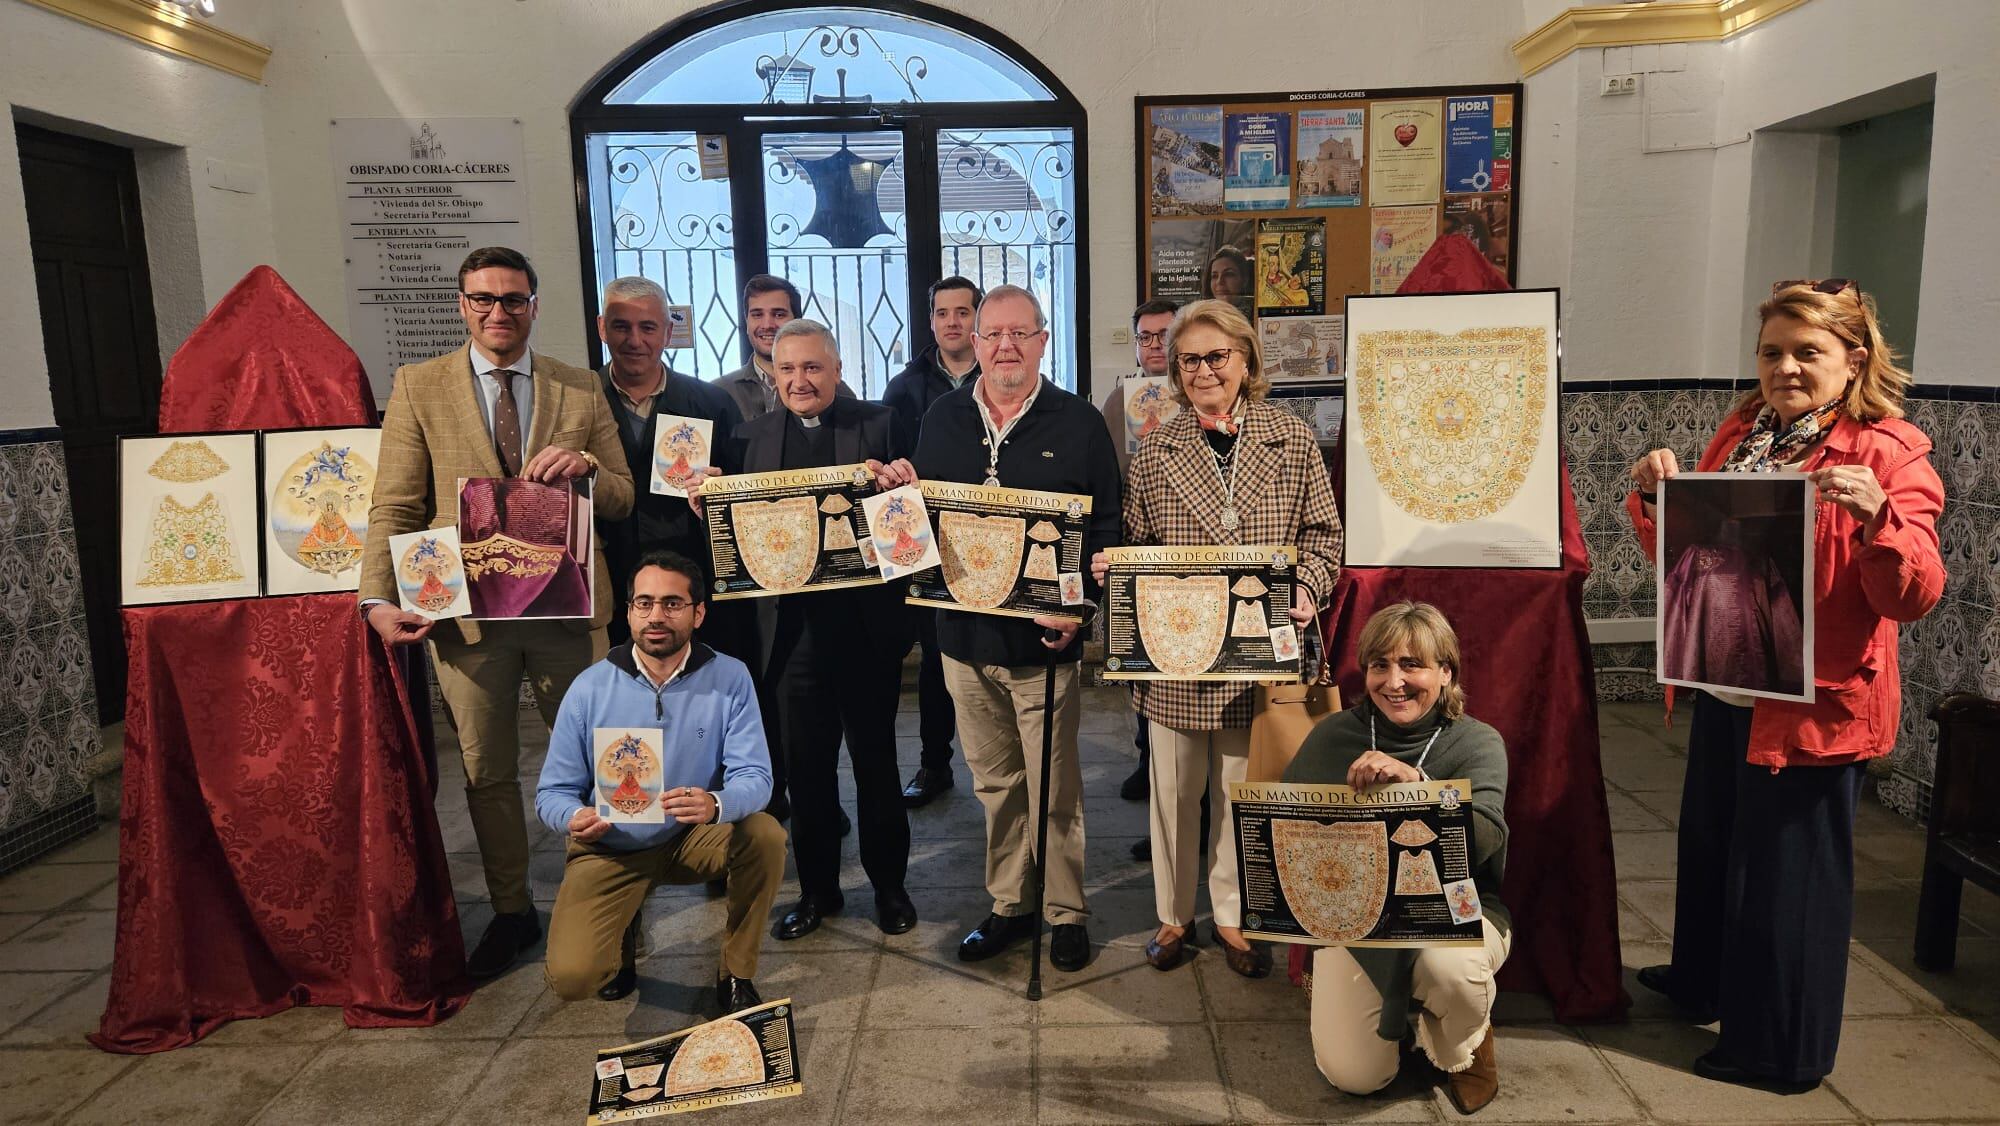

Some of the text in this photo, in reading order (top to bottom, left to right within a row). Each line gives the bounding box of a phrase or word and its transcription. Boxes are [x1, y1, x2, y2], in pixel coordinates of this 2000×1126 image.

[1318, 91, 1365, 99] CORIA-CÁCERES
[1457, 101, 1489, 112] HORA
[1346, 112, 1362, 125] 2024
[350, 162, 510, 175] OBISPADO CORIA-CÁCERES
[364, 186, 453, 195] PLANTA SUPERIOR
[380, 200, 420, 208] Vivienda
[452, 199, 483, 208] Obispo
[432, 210, 470, 219] Personal
[368, 228, 437, 236] ENTREPLANTA
[435, 241, 470, 249] General
[390, 275, 459, 283] Vivienda Conse
[375, 293, 412, 301] PLANTA
[428, 317, 464, 325] Asuntos
[395, 327, 464, 337] Administración
[431, 339, 466, 347] Judicial
[706, 472, 845, 492] UN MANTO DE CARIDAD
[939, 487, 983, 500] MANTO
[987, 492, 1003, 502] DE
[1006, 494, 1061, 508] CARIDAD
[1111, 551, 1264, 562] UN MANTO DE CARIDAD
[1239, 789, 1429, 804] UN MANTO DE CARIDAD
[717, 1089, 769, 1102] MANTO
[774, 1086, 795, 1096] UN
[624, 1102, 691, 1116] CARIDAD
